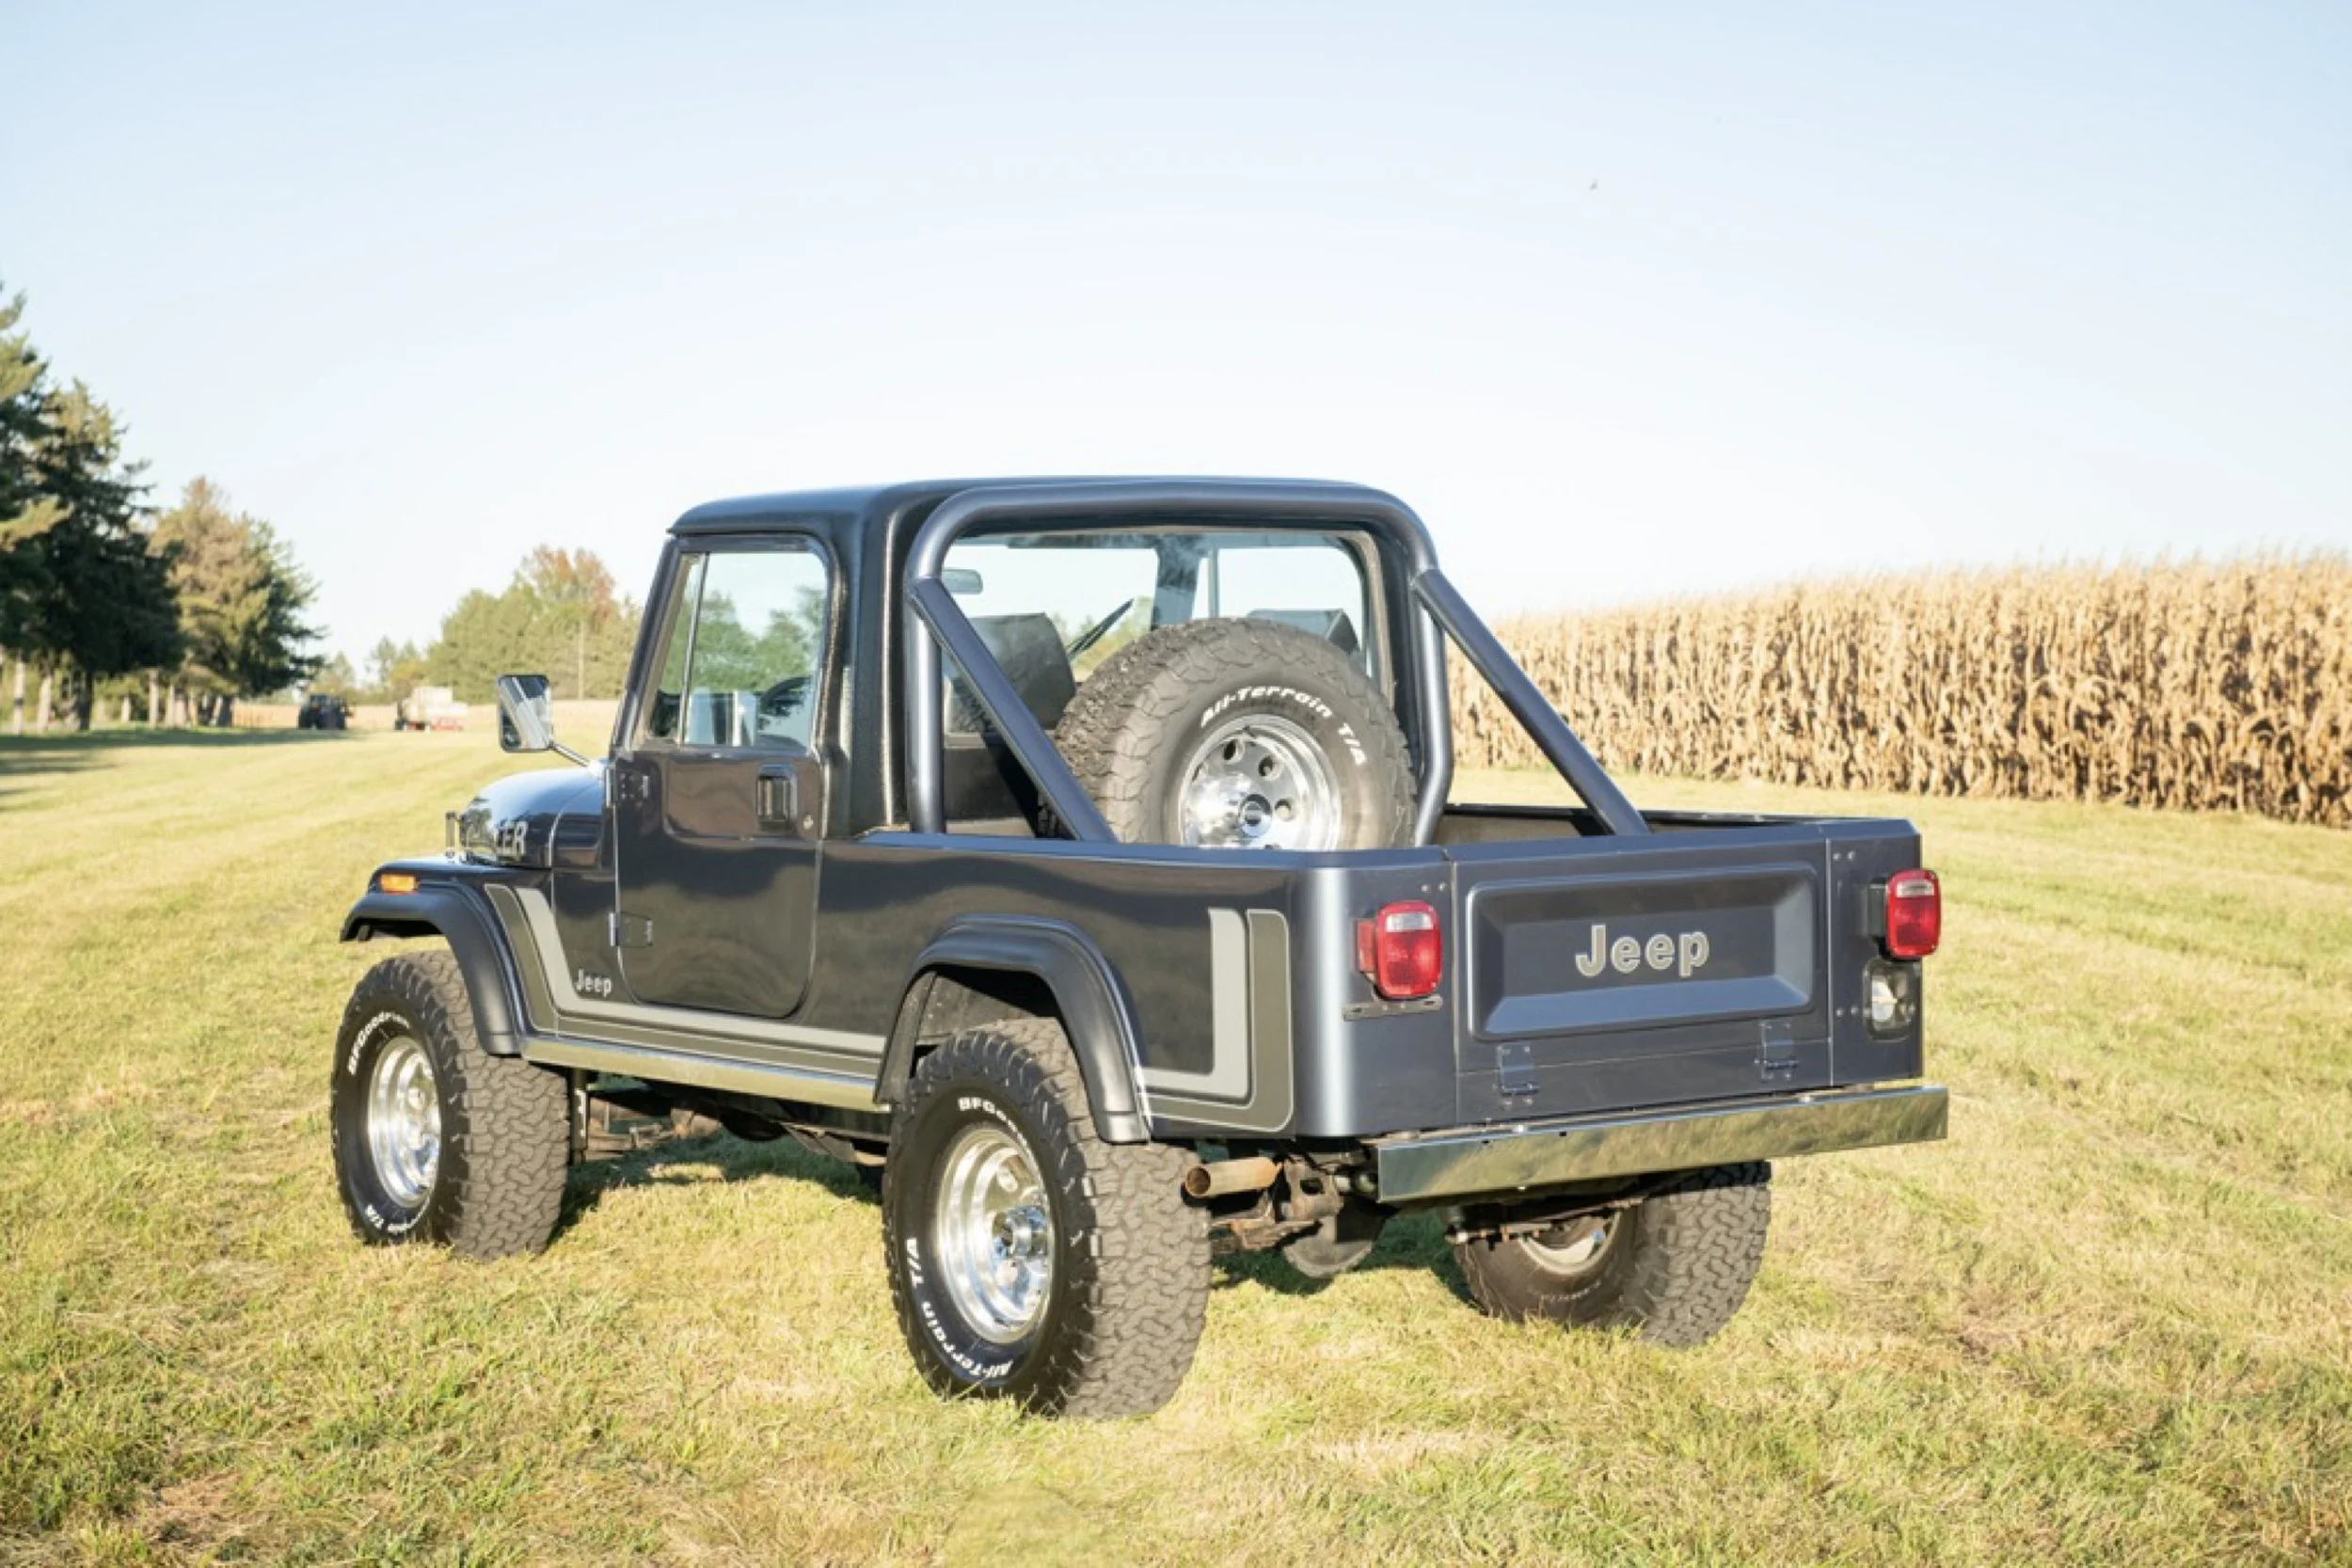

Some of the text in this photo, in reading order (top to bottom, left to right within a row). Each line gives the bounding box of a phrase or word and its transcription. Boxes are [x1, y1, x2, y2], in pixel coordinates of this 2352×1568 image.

[1338, 722, 1367, 766] T/A
[1575, 923, 1710, 978] Jeep
[575, 968, 613, 998] Jeep
